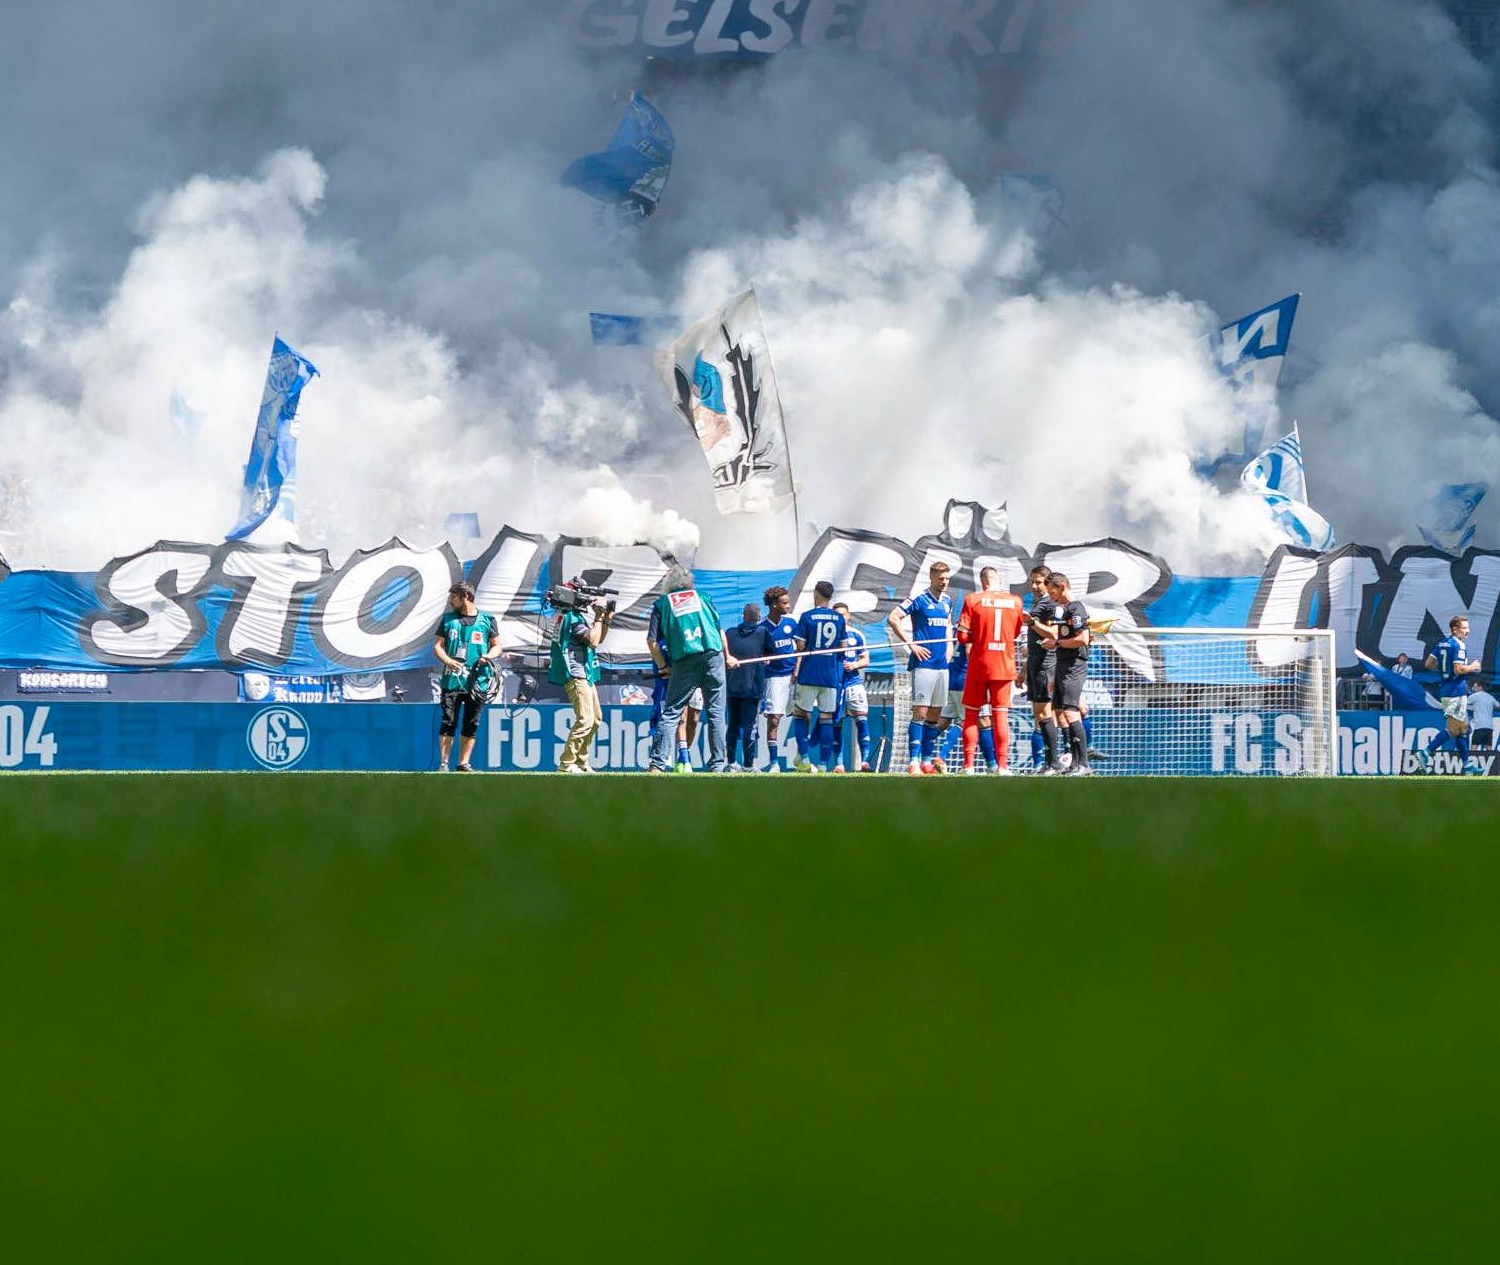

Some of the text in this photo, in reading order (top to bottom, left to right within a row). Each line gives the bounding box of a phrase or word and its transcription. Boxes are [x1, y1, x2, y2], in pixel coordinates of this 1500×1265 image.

[684, 627, 703, 641] 14
[815, 622, 837, 648] 19
[488, 708, 541, 768] FC
[1211, 713, 1262, 775] FC
